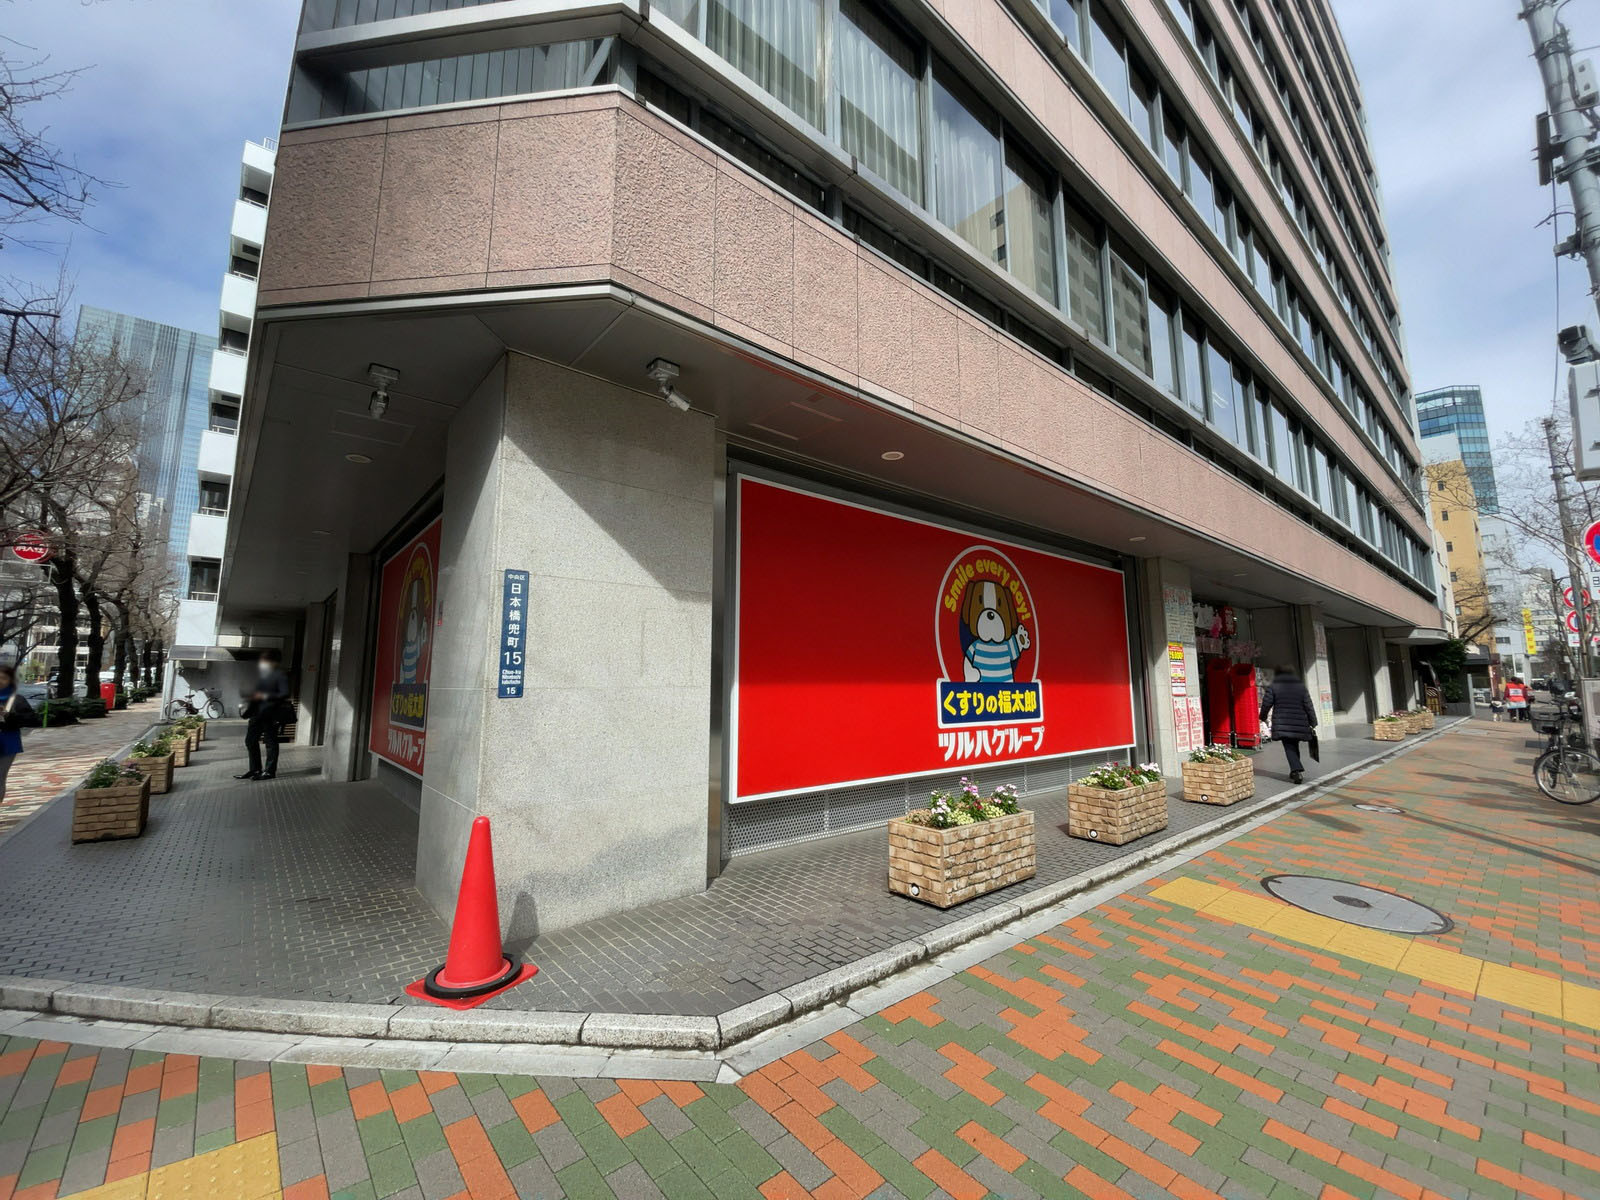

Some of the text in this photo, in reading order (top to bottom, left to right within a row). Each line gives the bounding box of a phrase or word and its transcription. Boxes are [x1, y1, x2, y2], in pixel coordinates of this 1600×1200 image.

[507, 573, 526, 581] 中央区
[944, 559, 1031, 621] Smile every day!
[507, 583, 522, 649] 日本橋兜町
[504, 651, 522, 666] 15
[506, 686, 516, 695] 15
[943, 690, 1037, 716] くすりの福太郎
[938, 726, 1045, 761] ツルハグループ
